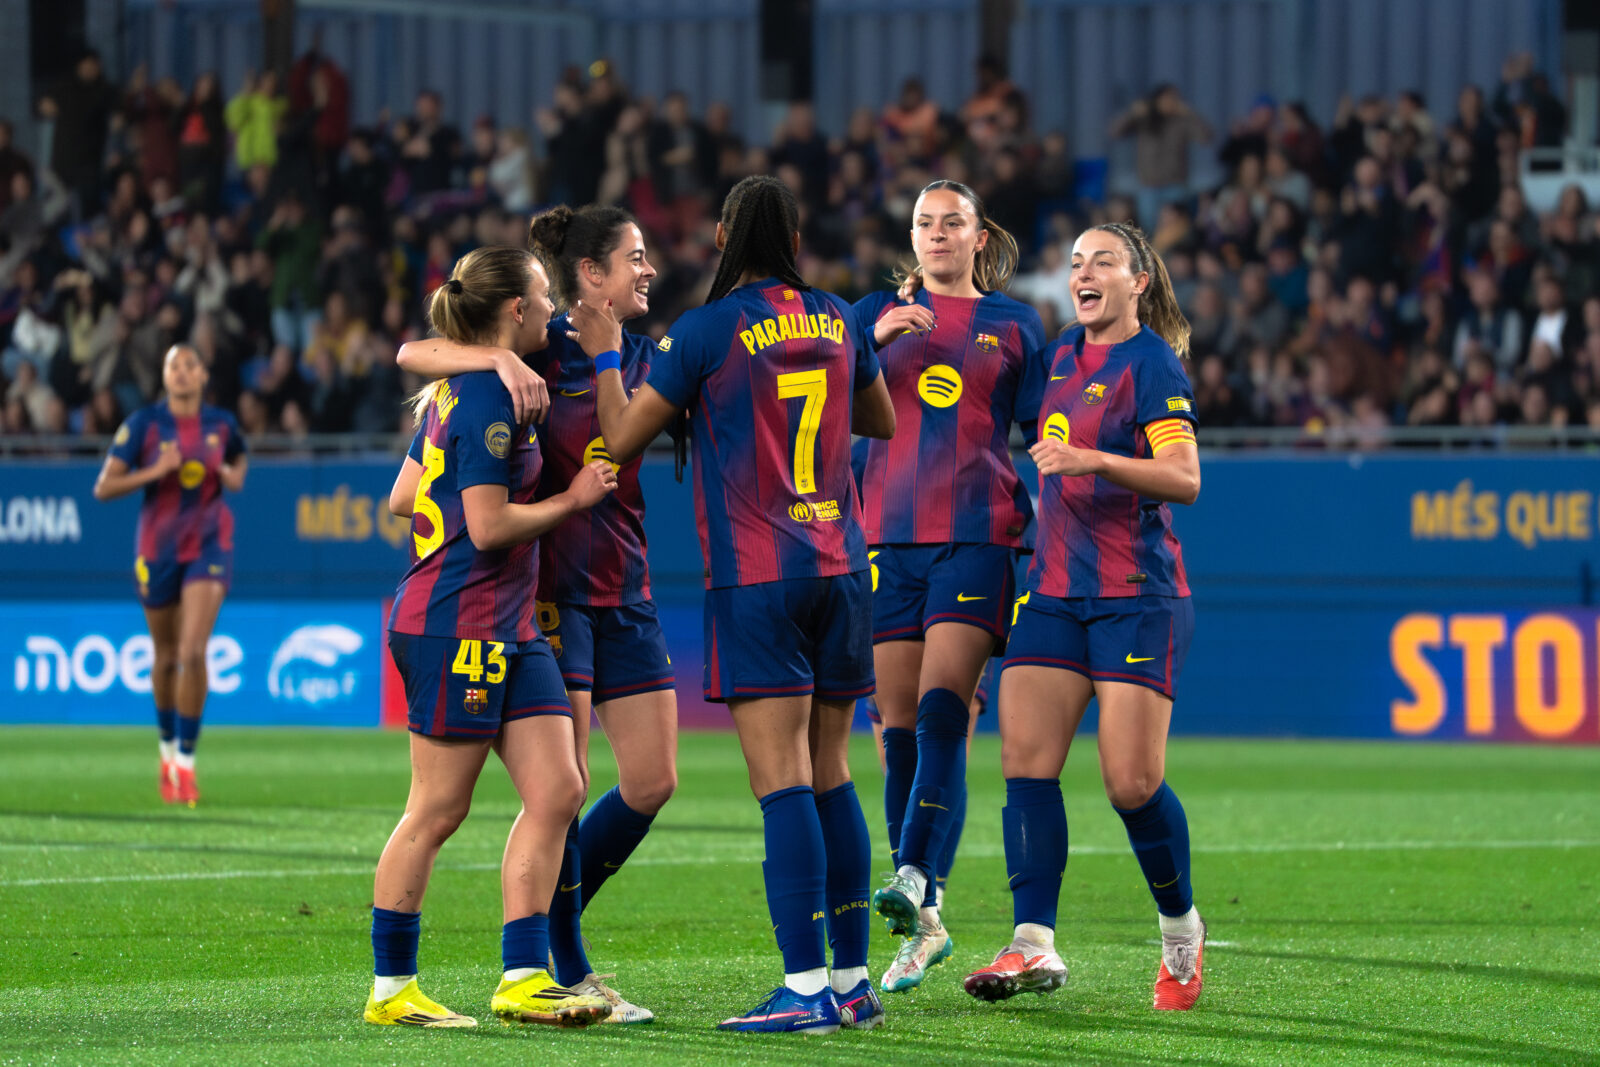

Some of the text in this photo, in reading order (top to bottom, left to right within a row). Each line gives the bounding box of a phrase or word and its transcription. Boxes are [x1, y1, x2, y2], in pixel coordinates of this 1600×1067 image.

[739, 313, 844, 356] PARALLUELO
[777, 368, 827, 495] 7
[1411, 477, 1499, 541] MÉS
[1505, 490, 1592, 550] QUE
[14, 634, 243, 694] moee
[452, 639, 507, 684] 43
[1390, 612, 1600, 738] STO
